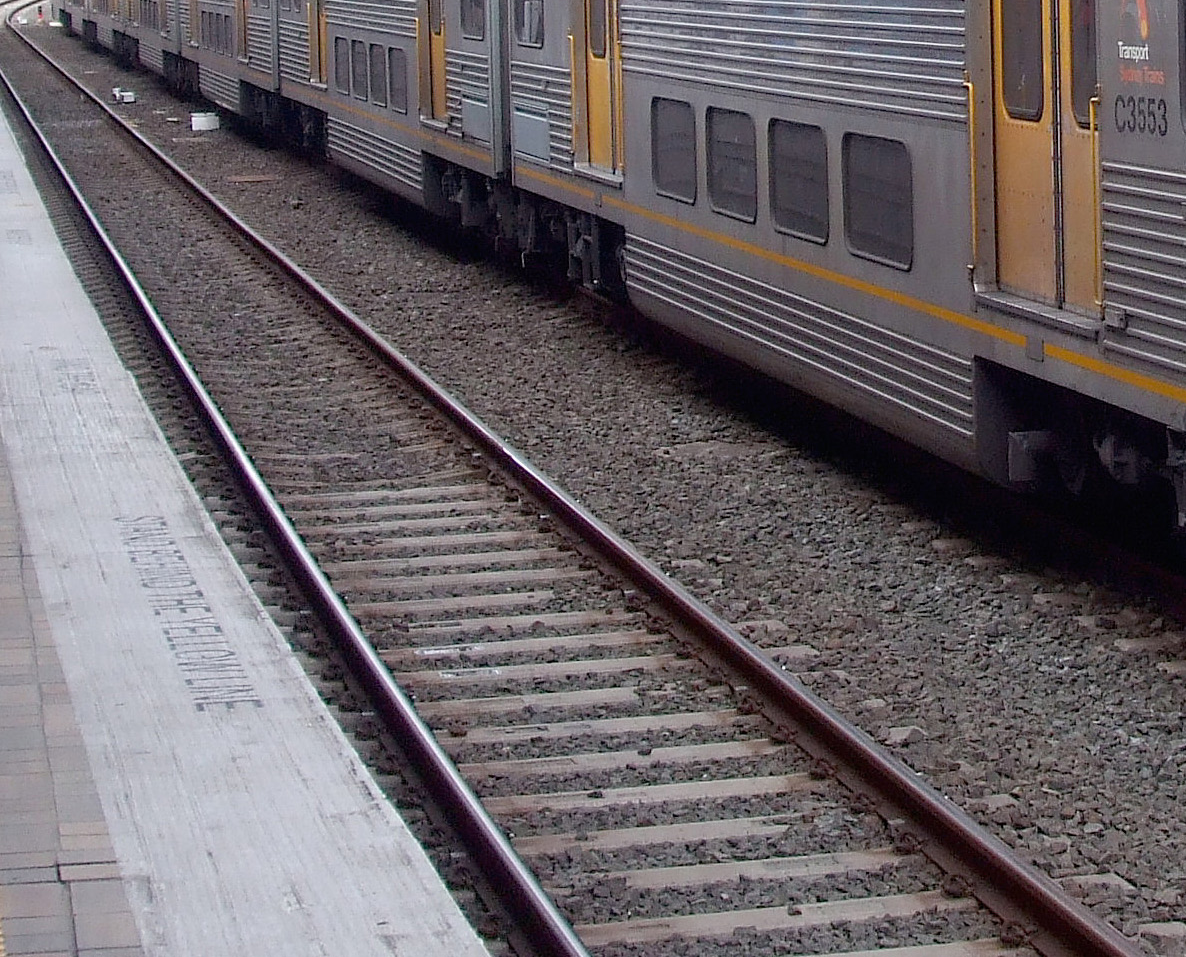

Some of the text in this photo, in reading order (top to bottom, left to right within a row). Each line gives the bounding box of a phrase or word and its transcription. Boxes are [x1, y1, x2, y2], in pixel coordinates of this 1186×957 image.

[1117, 41, 1149, 63] Transport
[1114, 94, 1168, 136] C3553
[146, 590, 212, 616] THE
[160, 616, 245, 673] YELLOW
[184, 675, 265, 713] LINE
